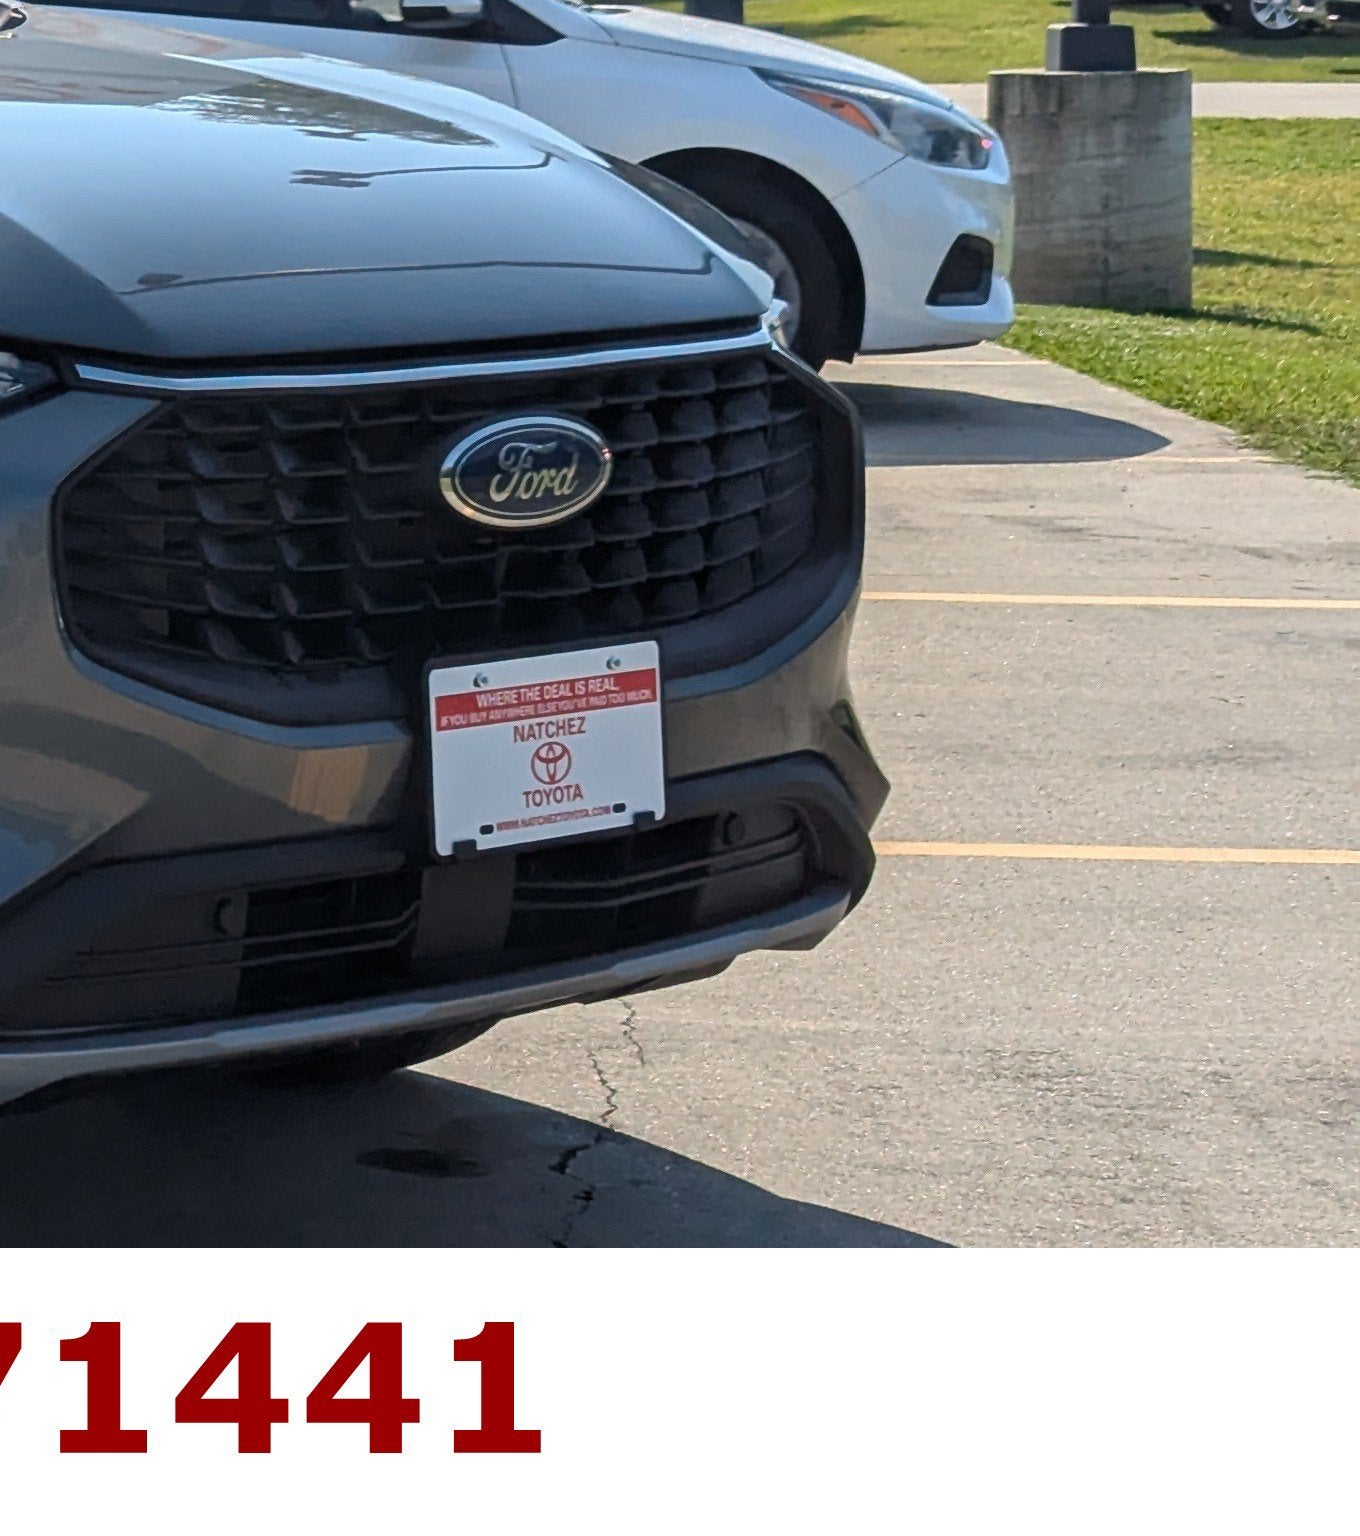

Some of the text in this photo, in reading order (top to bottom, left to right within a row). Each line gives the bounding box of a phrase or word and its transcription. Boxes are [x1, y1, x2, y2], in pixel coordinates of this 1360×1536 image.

[489, 442, 579, 502] Ford
[476, 676, 619, 708] WHERE THE DEAL IS REAL
[513, 716, 586, 743] NATCHEZ
[522, 783, 584, 808] TOYOTA
